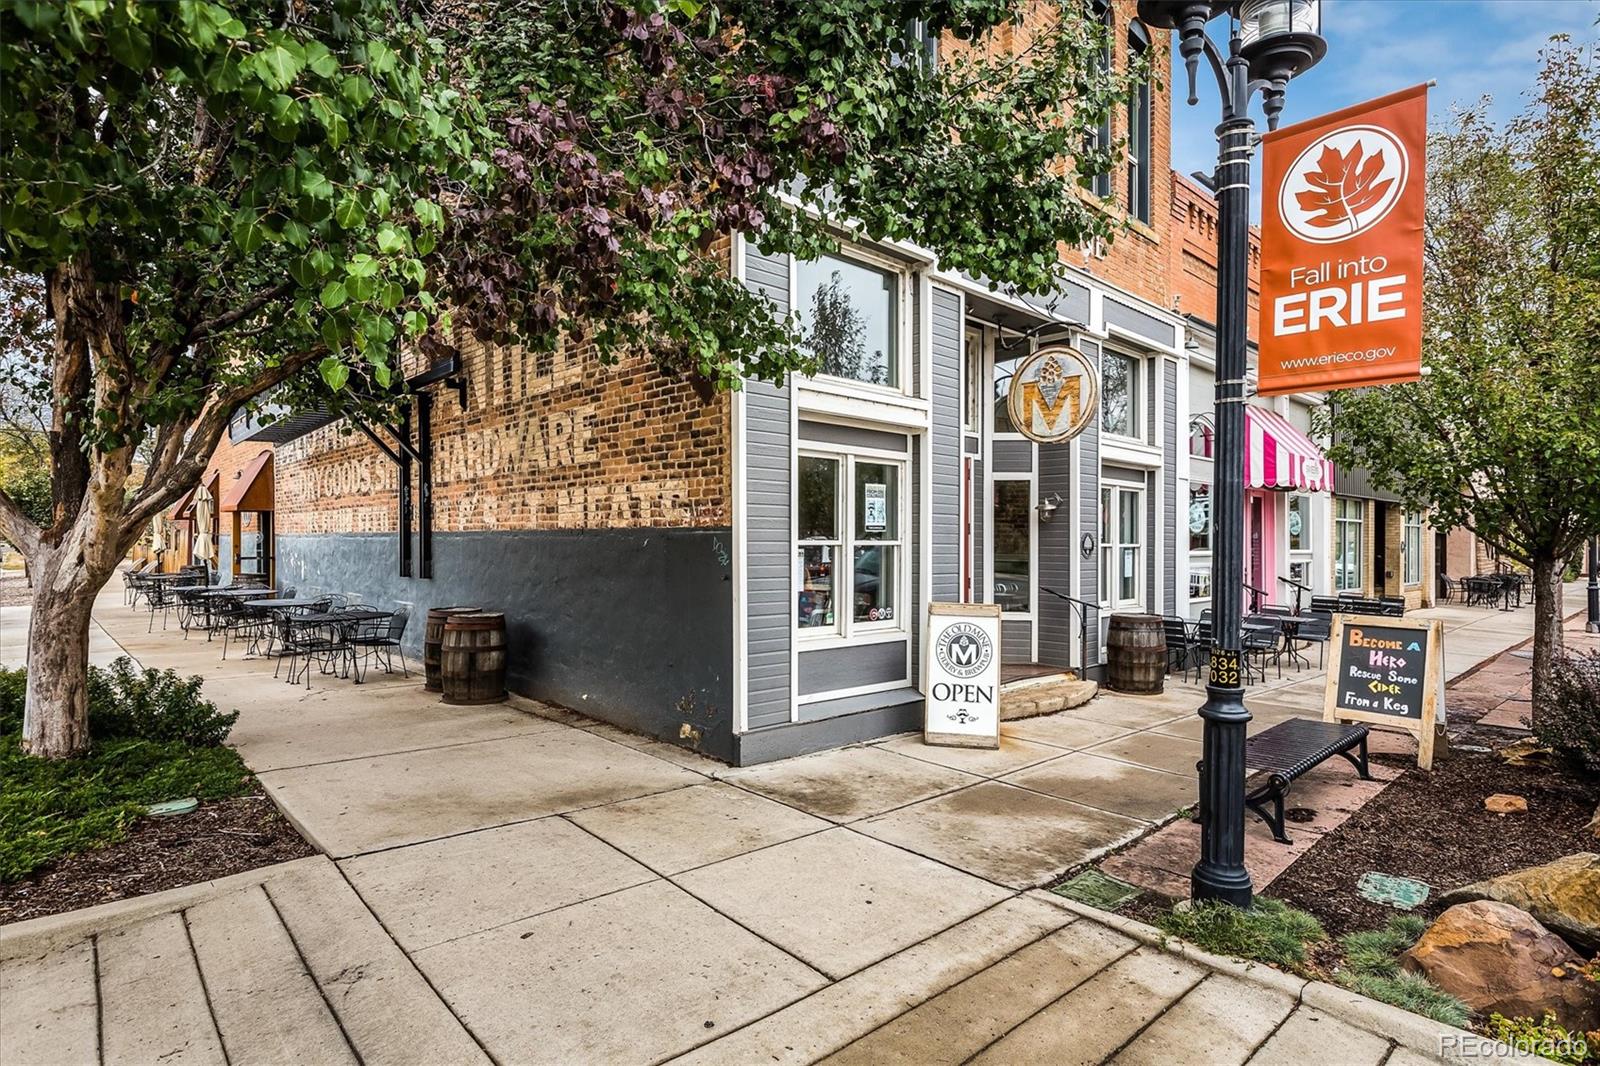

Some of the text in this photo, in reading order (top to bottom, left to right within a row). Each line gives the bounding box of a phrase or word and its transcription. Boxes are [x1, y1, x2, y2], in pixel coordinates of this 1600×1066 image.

[1290, 255, 1388, 288] Fall into
[1273, 274, 1406, 337] ERIE
[1280, 346, 1396, 369] www.erieco.gov
[431, 405, 598, 483] HARDWARE
[939, 624, 990, 648] THE OLD MINE
[1407, 641, 1421, 652] A
[1211, 655, 1238, 670] 834
[1210, 670, 1237, 683] 032
[1349, 665, 1418, 685] Rescue Some
[932, 683, 993, 703] OPEN
[1368, 680, 1401, 695] CIDER
[1344, 691, 1409, 715] From a Keg
